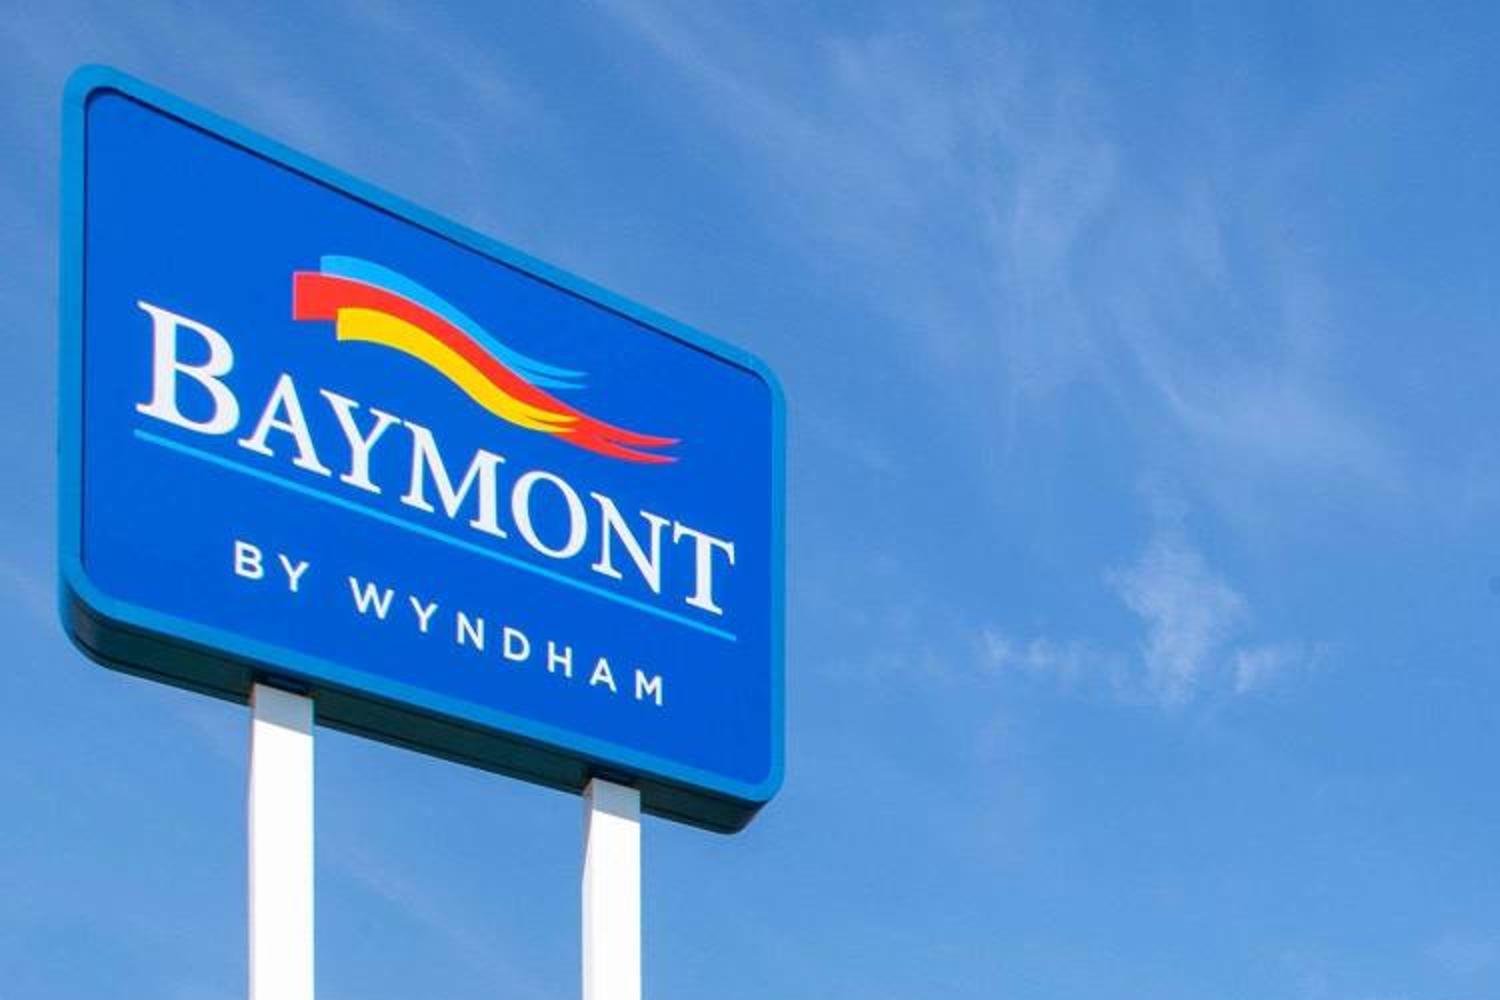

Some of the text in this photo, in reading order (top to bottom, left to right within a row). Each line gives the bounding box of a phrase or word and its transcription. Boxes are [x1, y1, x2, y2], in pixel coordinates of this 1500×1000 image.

[136, 301, 736, 615] BAYMONT
[234, 541, 663, 706] BY WYNDHAM
